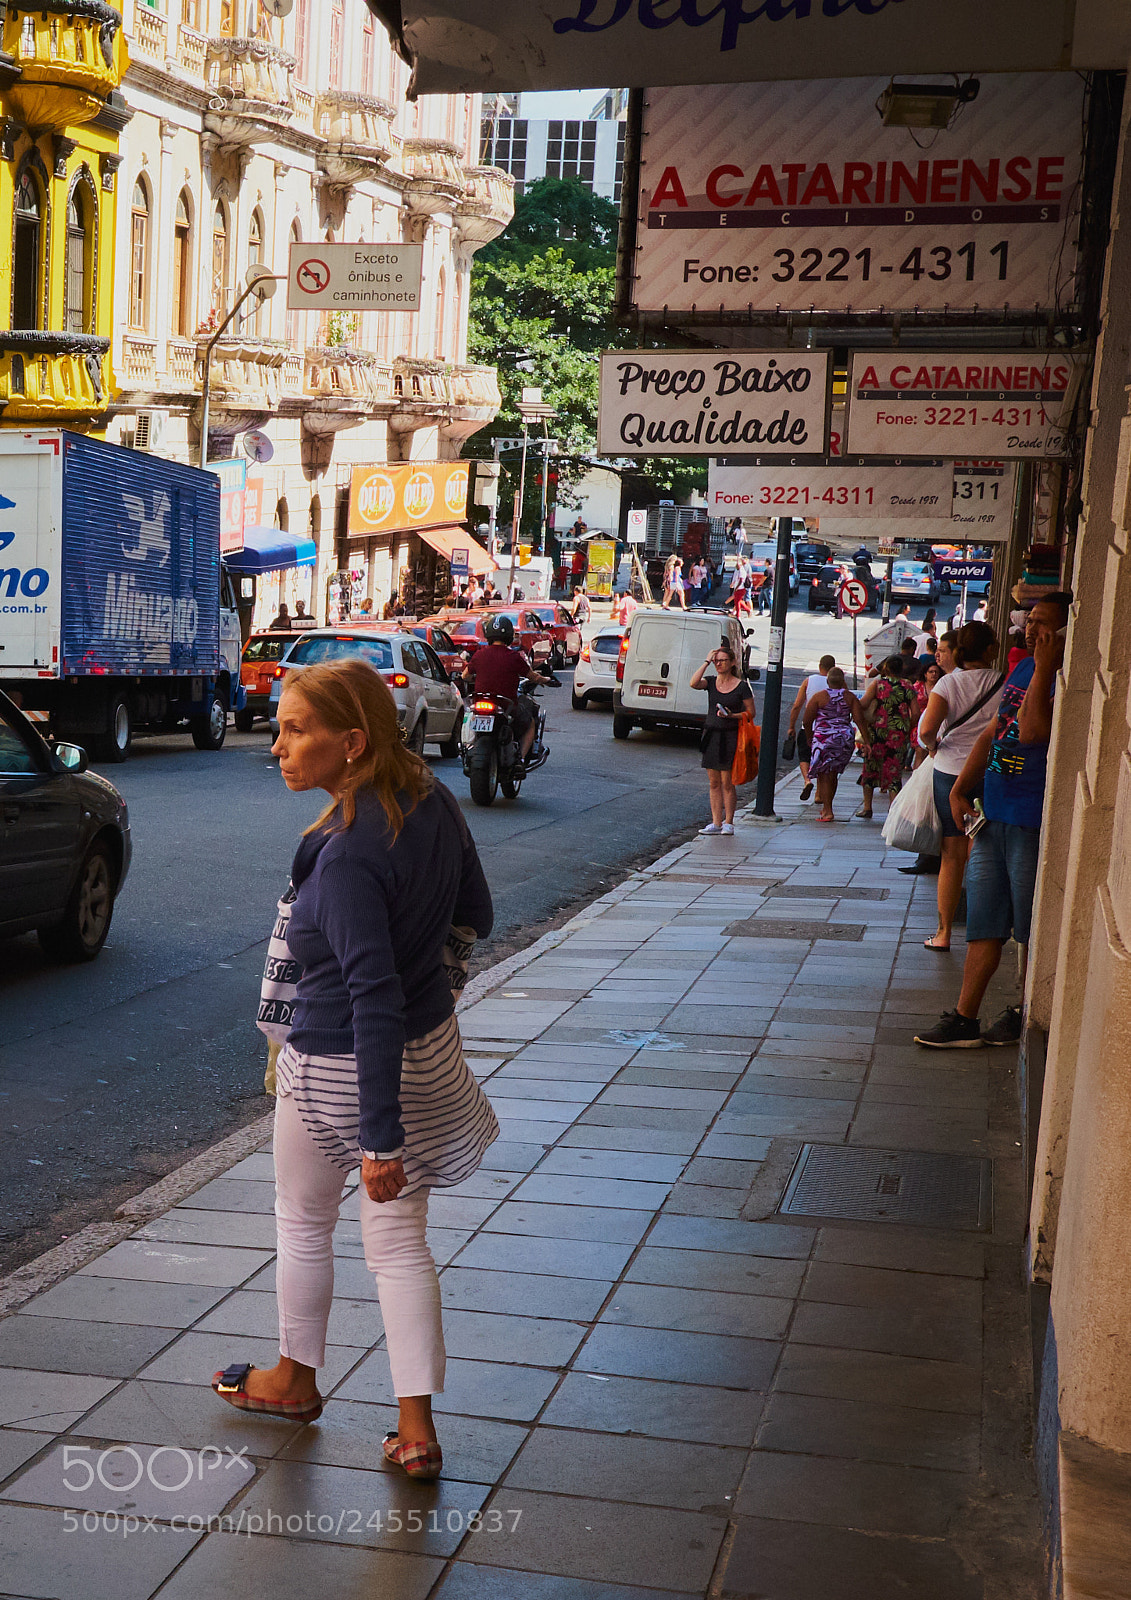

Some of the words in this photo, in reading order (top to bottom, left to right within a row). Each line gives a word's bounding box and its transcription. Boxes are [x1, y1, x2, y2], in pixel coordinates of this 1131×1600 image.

[649, 166, 688, 208] A
[705, 156, 1066, 208] CATARINENSE
[354, 252, 399, 265] Exceto
[683, 259, 760, 283] Fone:
[771, 240, 1009, 282] 3221-4311
[348, 270, 391, 283] ônibus
[395, 273, 403, 283] e
[332, 290, 416, 302] caminhonete
[616, 362, 706, 400] Preço
[713, 359, 811, 396] Baixo
[858, 366, 880, 389] A
[889, 365, 1069, 391] CATARINENS
[702, 396, 712, 409] e
[876, 411, 918, 425] Fone:
[923, 407, 1046, 427] 3221-4311
[620, 409, 808, 448] Qualidade
[1007, 436, 1043, 449] Desde
[715, 491, 754, 505] Fone:
[759, 486, 875, 506] 3221-4311
[890, 495, 917, 506] Desde
[918, 495, 939, 505] 1981
[940, 565, 987, 577] PanVel
[102, 572, 199, 645] Minuano
